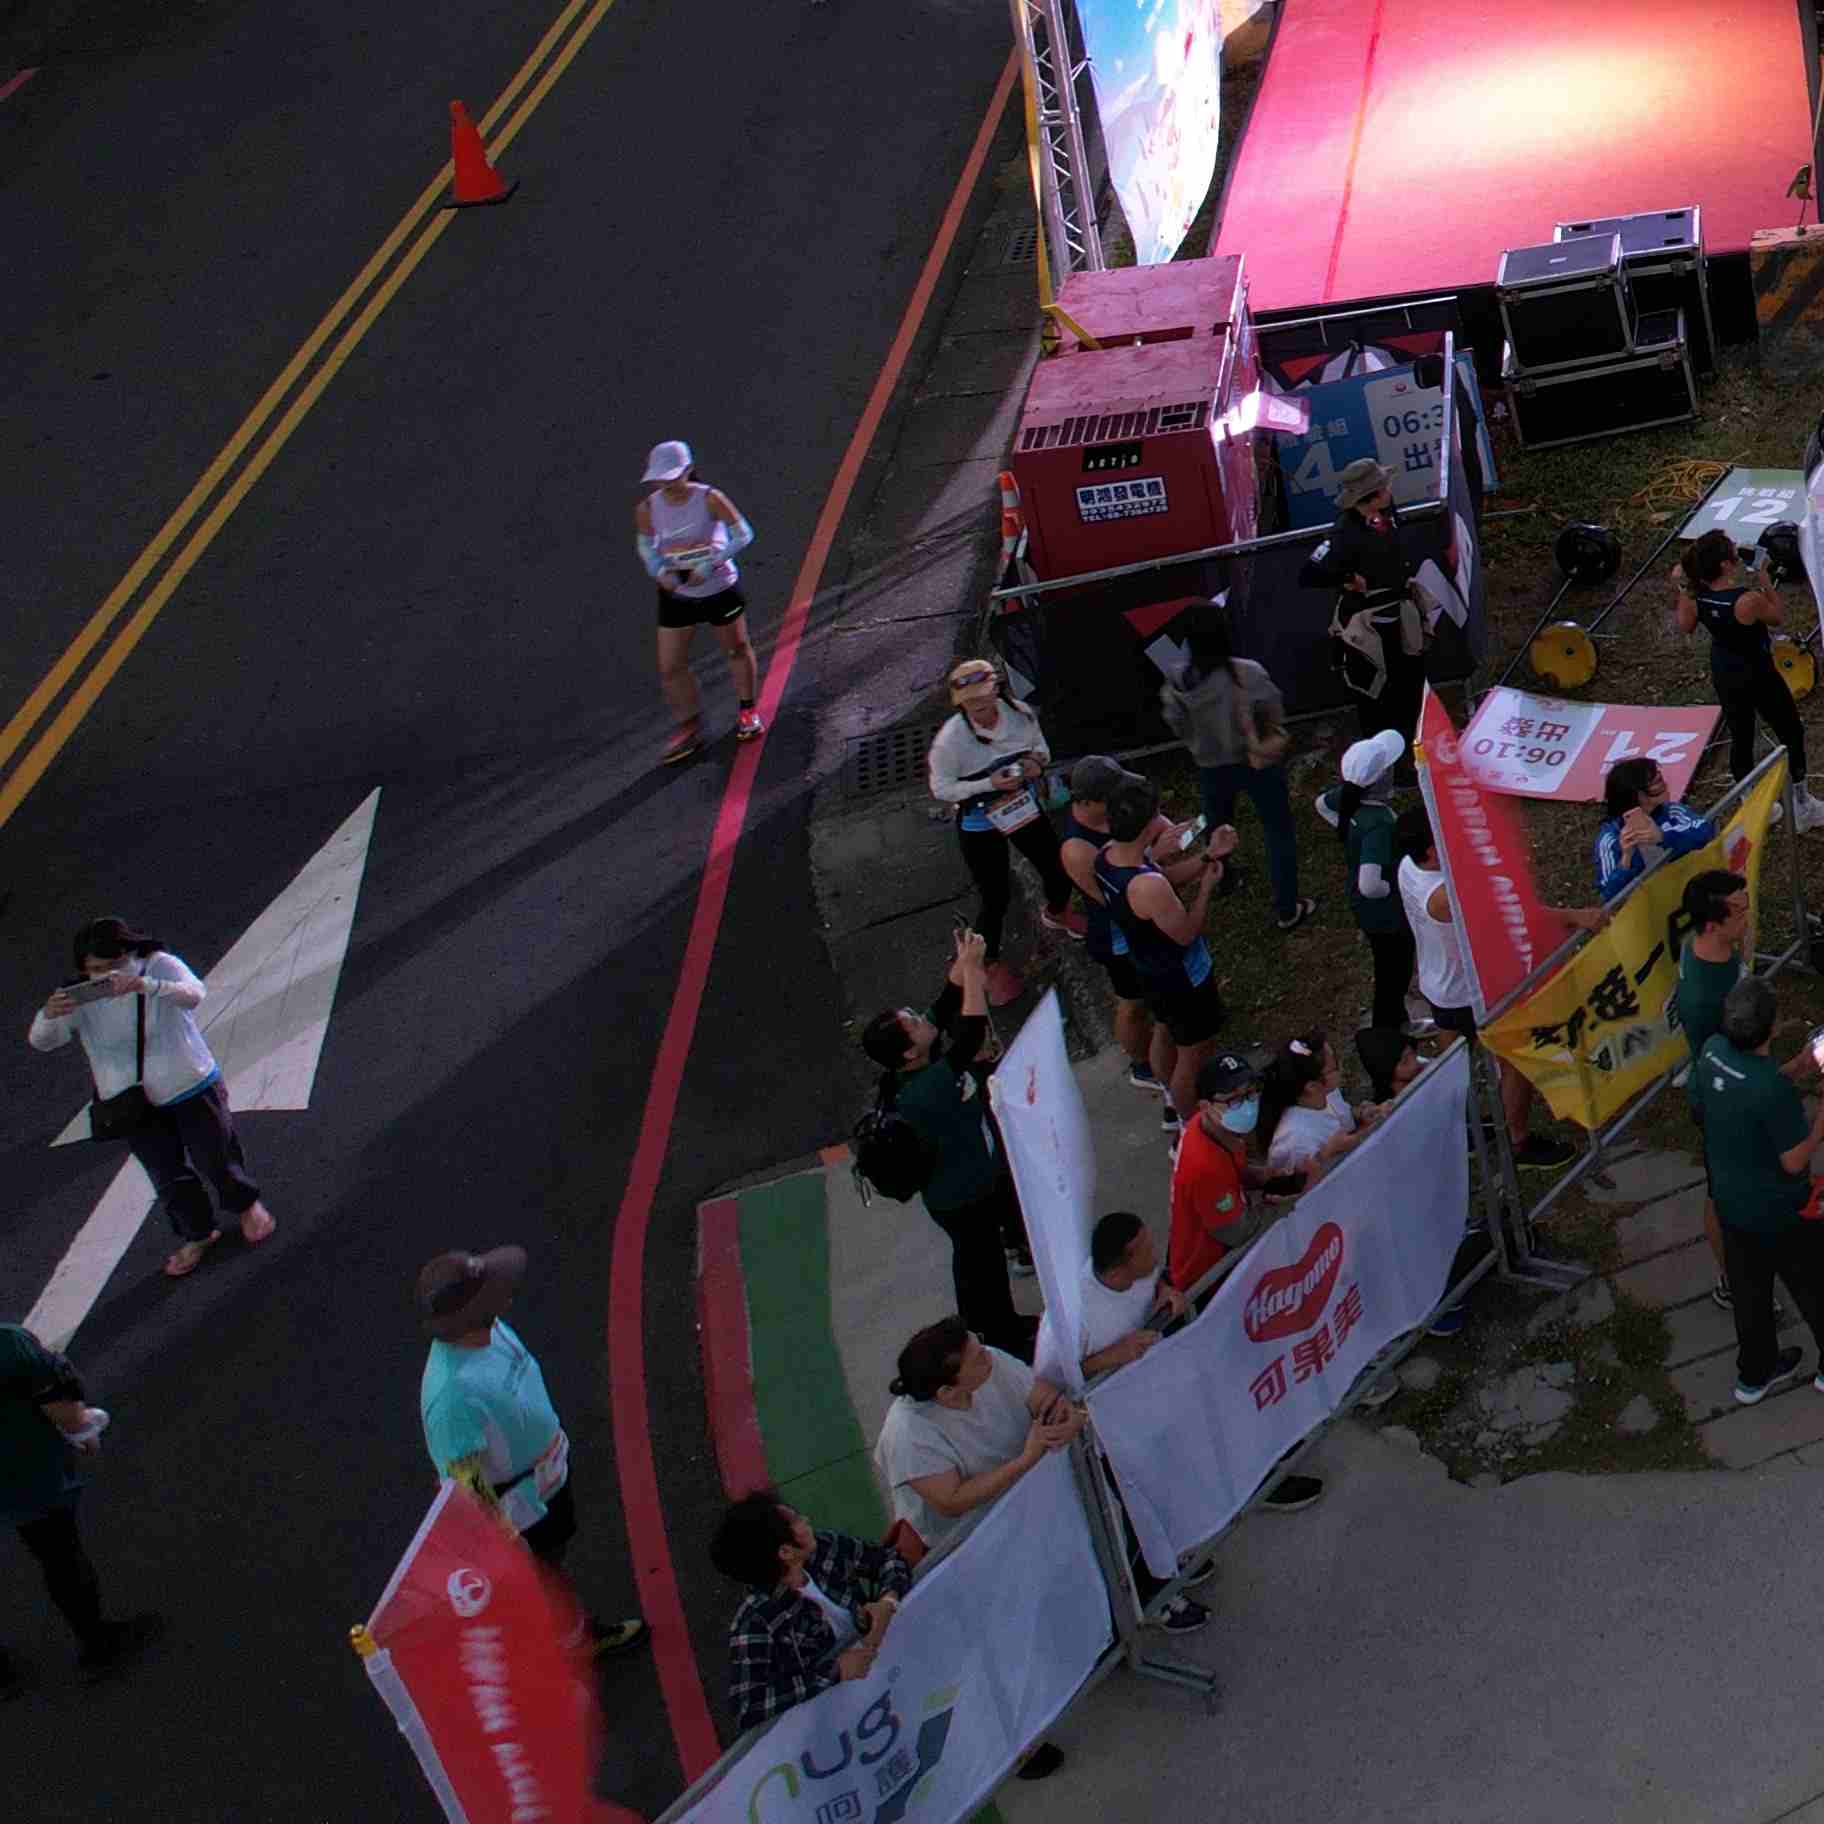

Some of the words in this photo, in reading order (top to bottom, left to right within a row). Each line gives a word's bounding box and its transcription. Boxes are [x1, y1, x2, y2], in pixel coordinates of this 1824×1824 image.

[1382, 405, 1443, 438] 06:3
[1403, 439, 1442, 473] 出
[1706, 495, 1788, 526] 12
[1500, 717, 1570, 745] 出發
[1602, 729, 1699, 765] 21
[1470, 736, 1567, 767] 06:10
[1248, 1236, 1342, 1334] Kagome
[1248, 1279, 1364, 1412] 可果美
